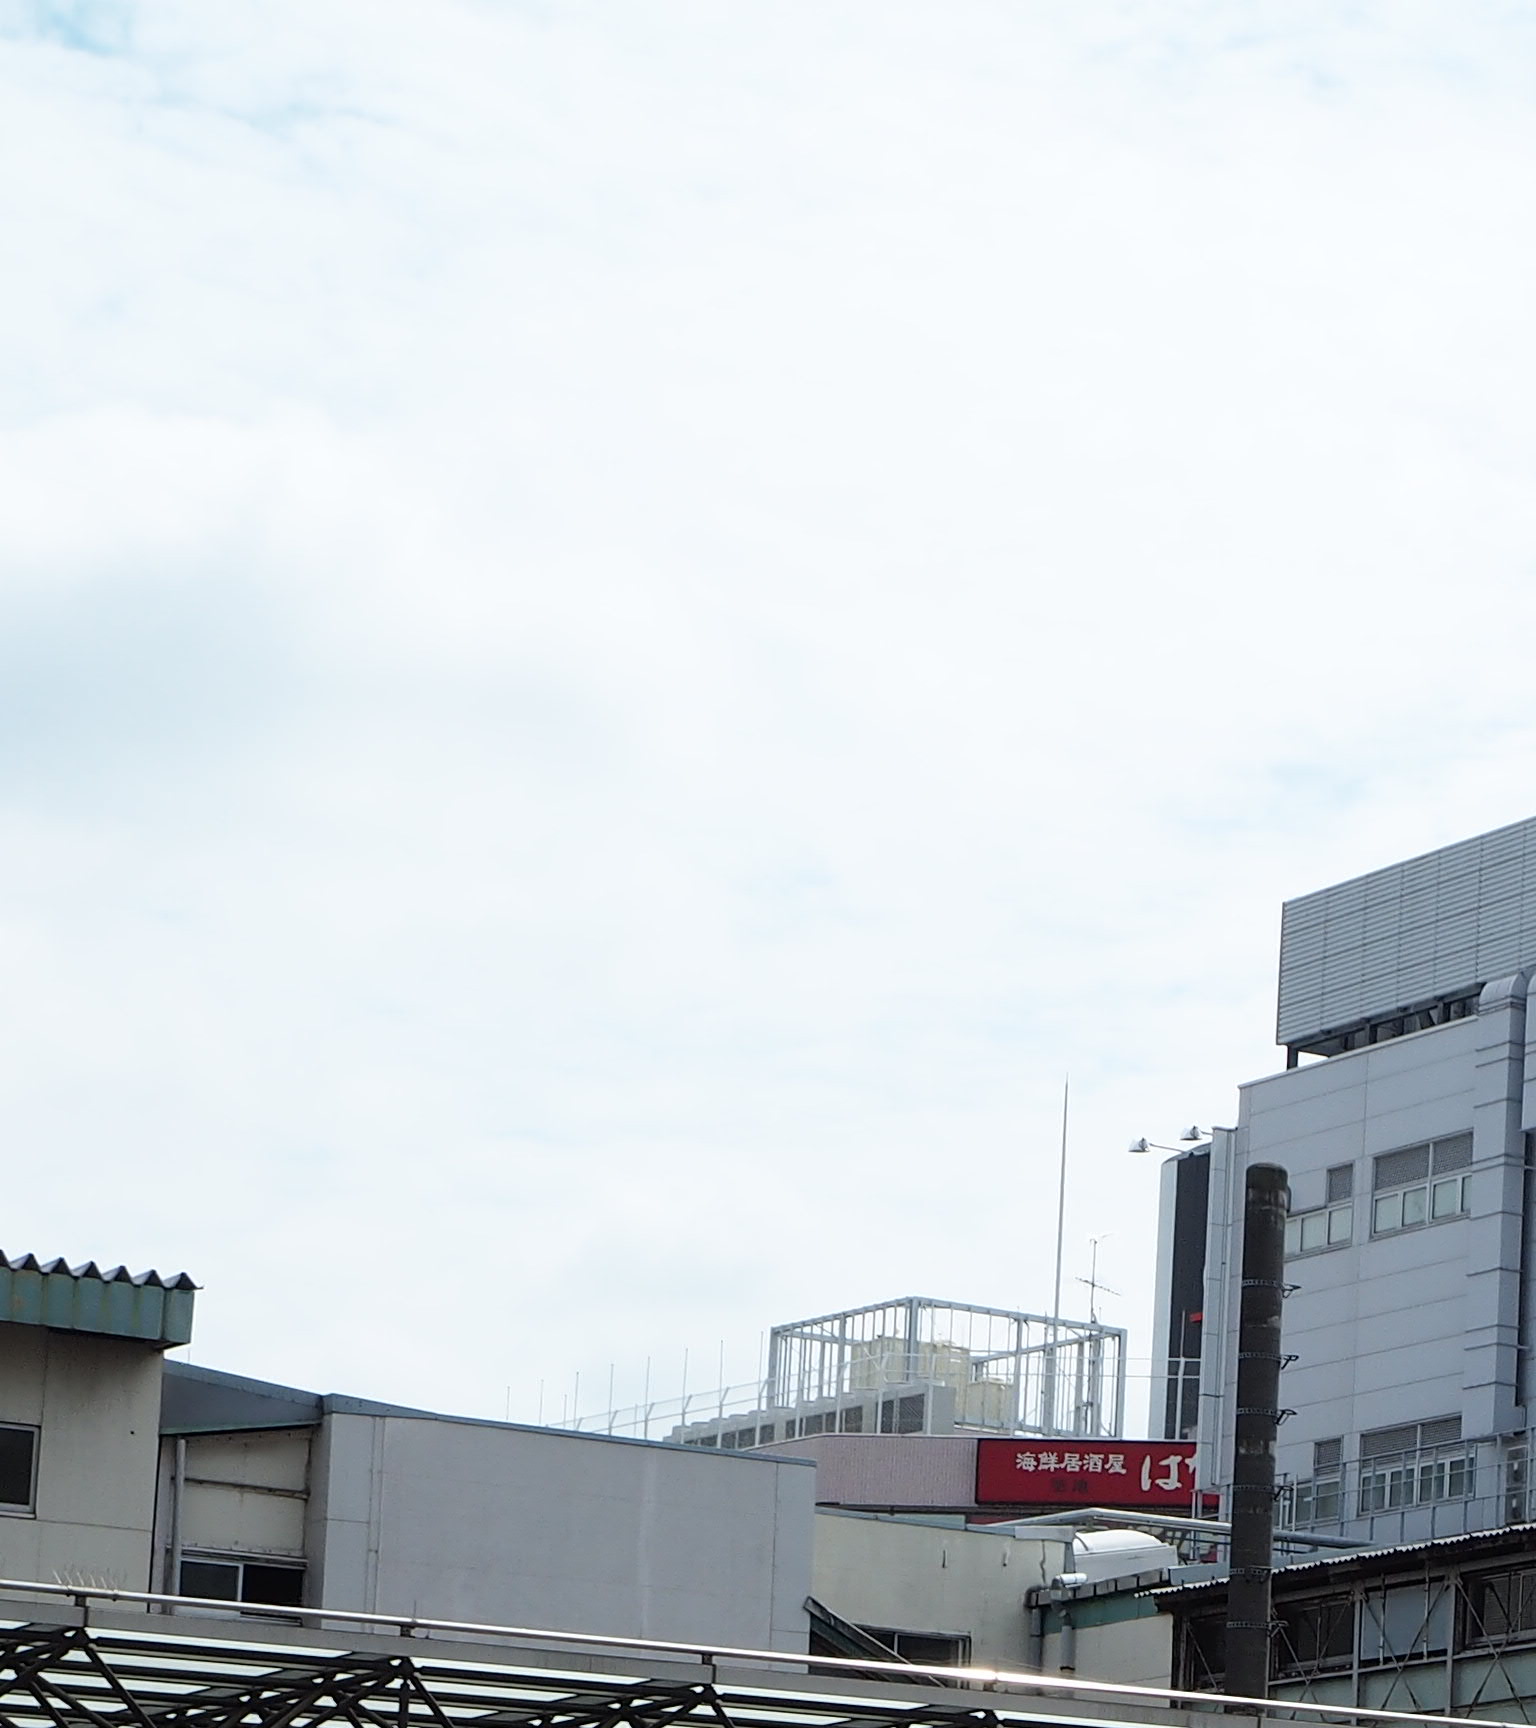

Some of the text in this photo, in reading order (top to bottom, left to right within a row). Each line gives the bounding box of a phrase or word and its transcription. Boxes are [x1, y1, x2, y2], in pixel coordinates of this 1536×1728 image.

[1015, 1452, 1127, 1475] 海鮮居酒屋
